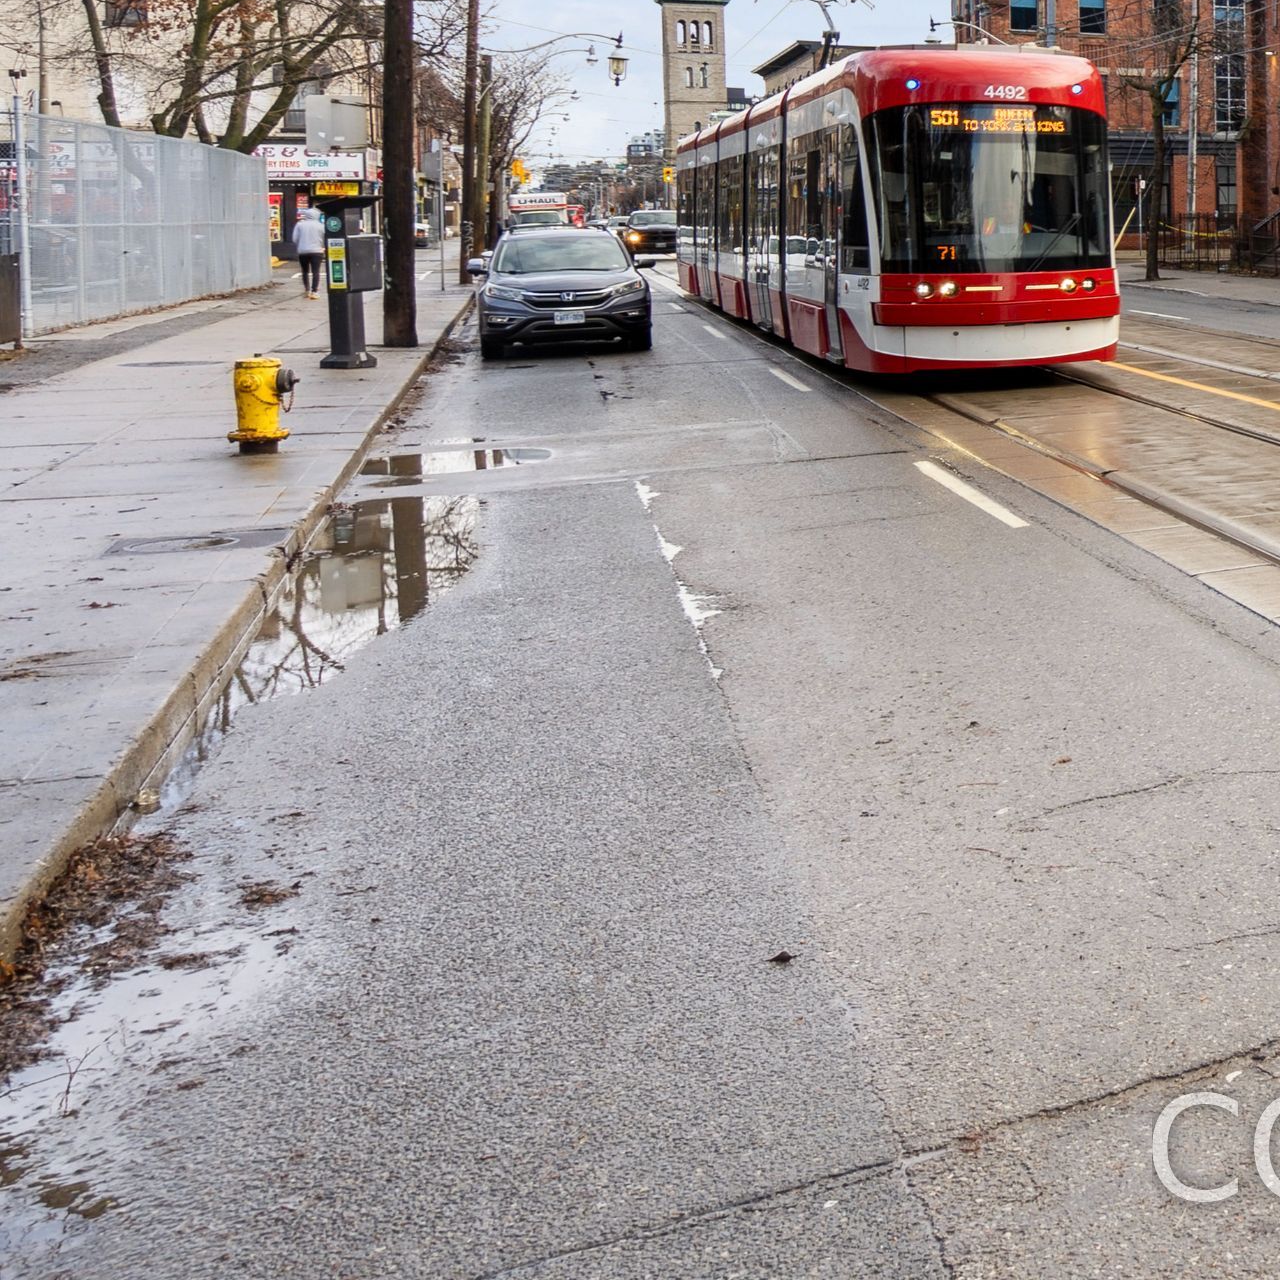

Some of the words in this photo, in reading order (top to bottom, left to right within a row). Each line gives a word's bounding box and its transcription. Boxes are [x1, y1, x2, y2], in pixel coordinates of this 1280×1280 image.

[984, 85, 1026, 100] 4492
[930, 109, 959, 126] 501
[994, 109, 1034, 120] QUEEN
[963, 120, 978, 131] TO
[981, 120, 1011, 131] YORK
[1037, 121, 1065, 132] KING
[307, 159, 329, 168] OPEN
[318, 182, 344, 192] ATM
[937, 245, 956, 260] 71
